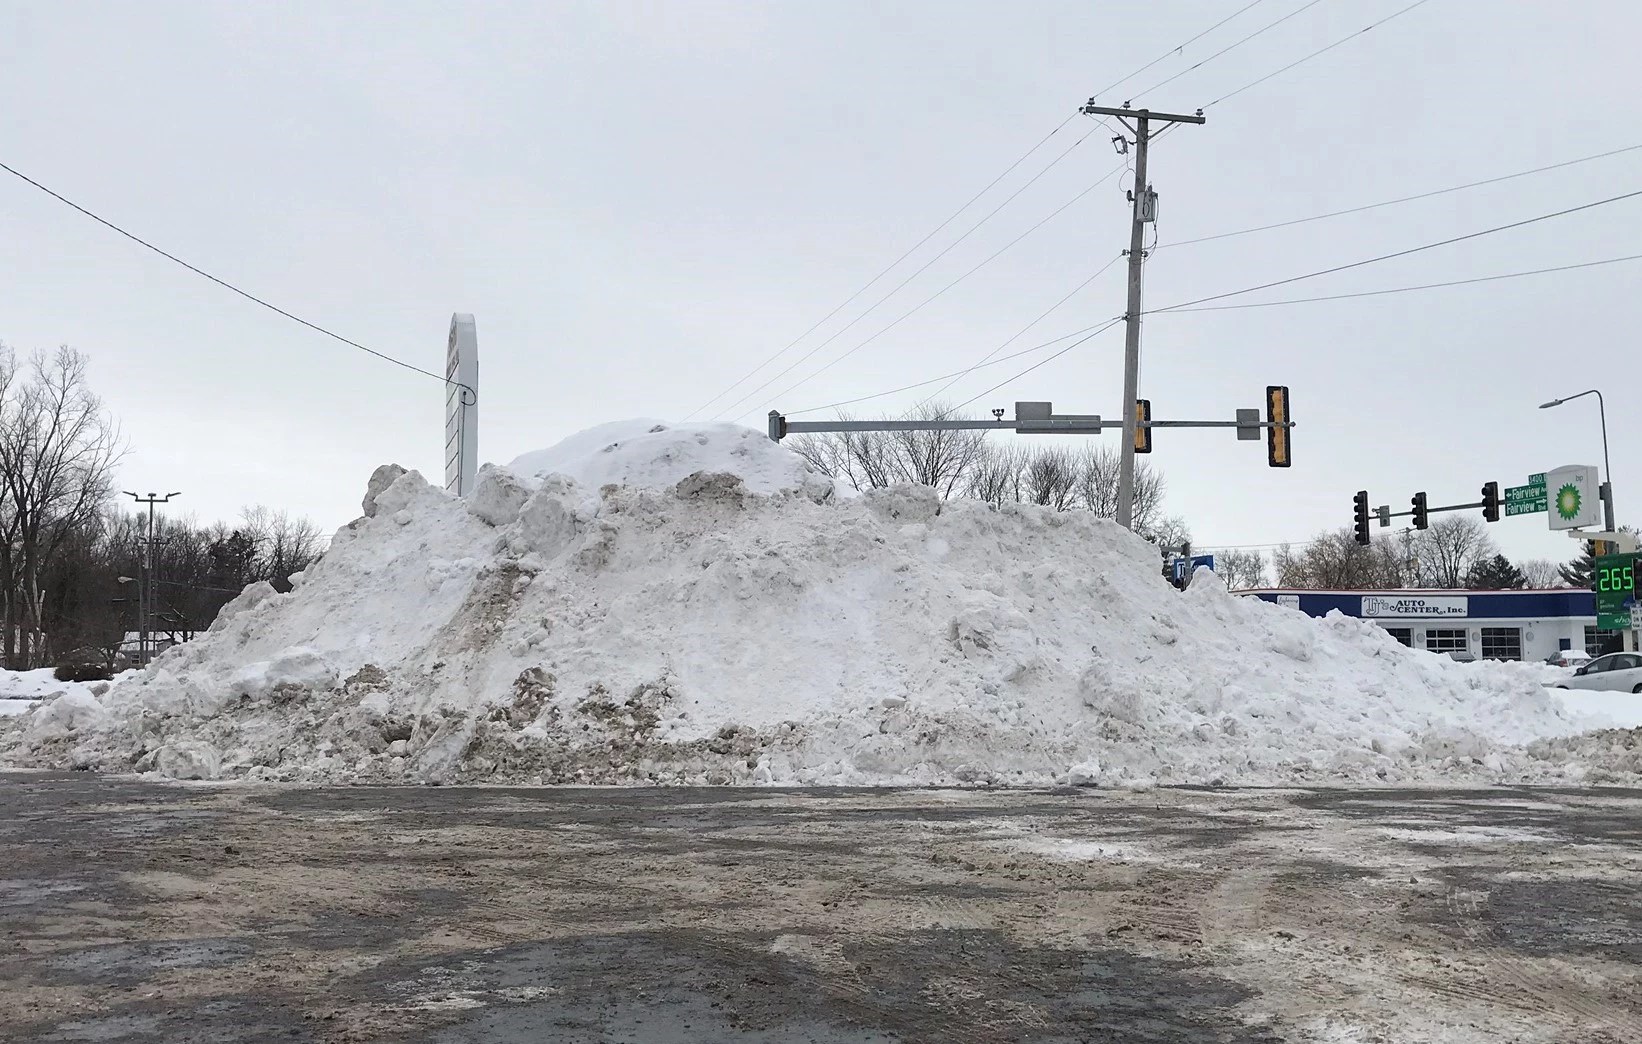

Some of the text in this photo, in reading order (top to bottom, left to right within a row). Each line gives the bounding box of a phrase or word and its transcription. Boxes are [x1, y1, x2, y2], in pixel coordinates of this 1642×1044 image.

[1512, 487, 1540, 499] Fairview
[1506, 503, 1535, 514] Fairview
[1600, 567, 1633, 591] 265
[1389, 600, 1425, 612] AUTO
